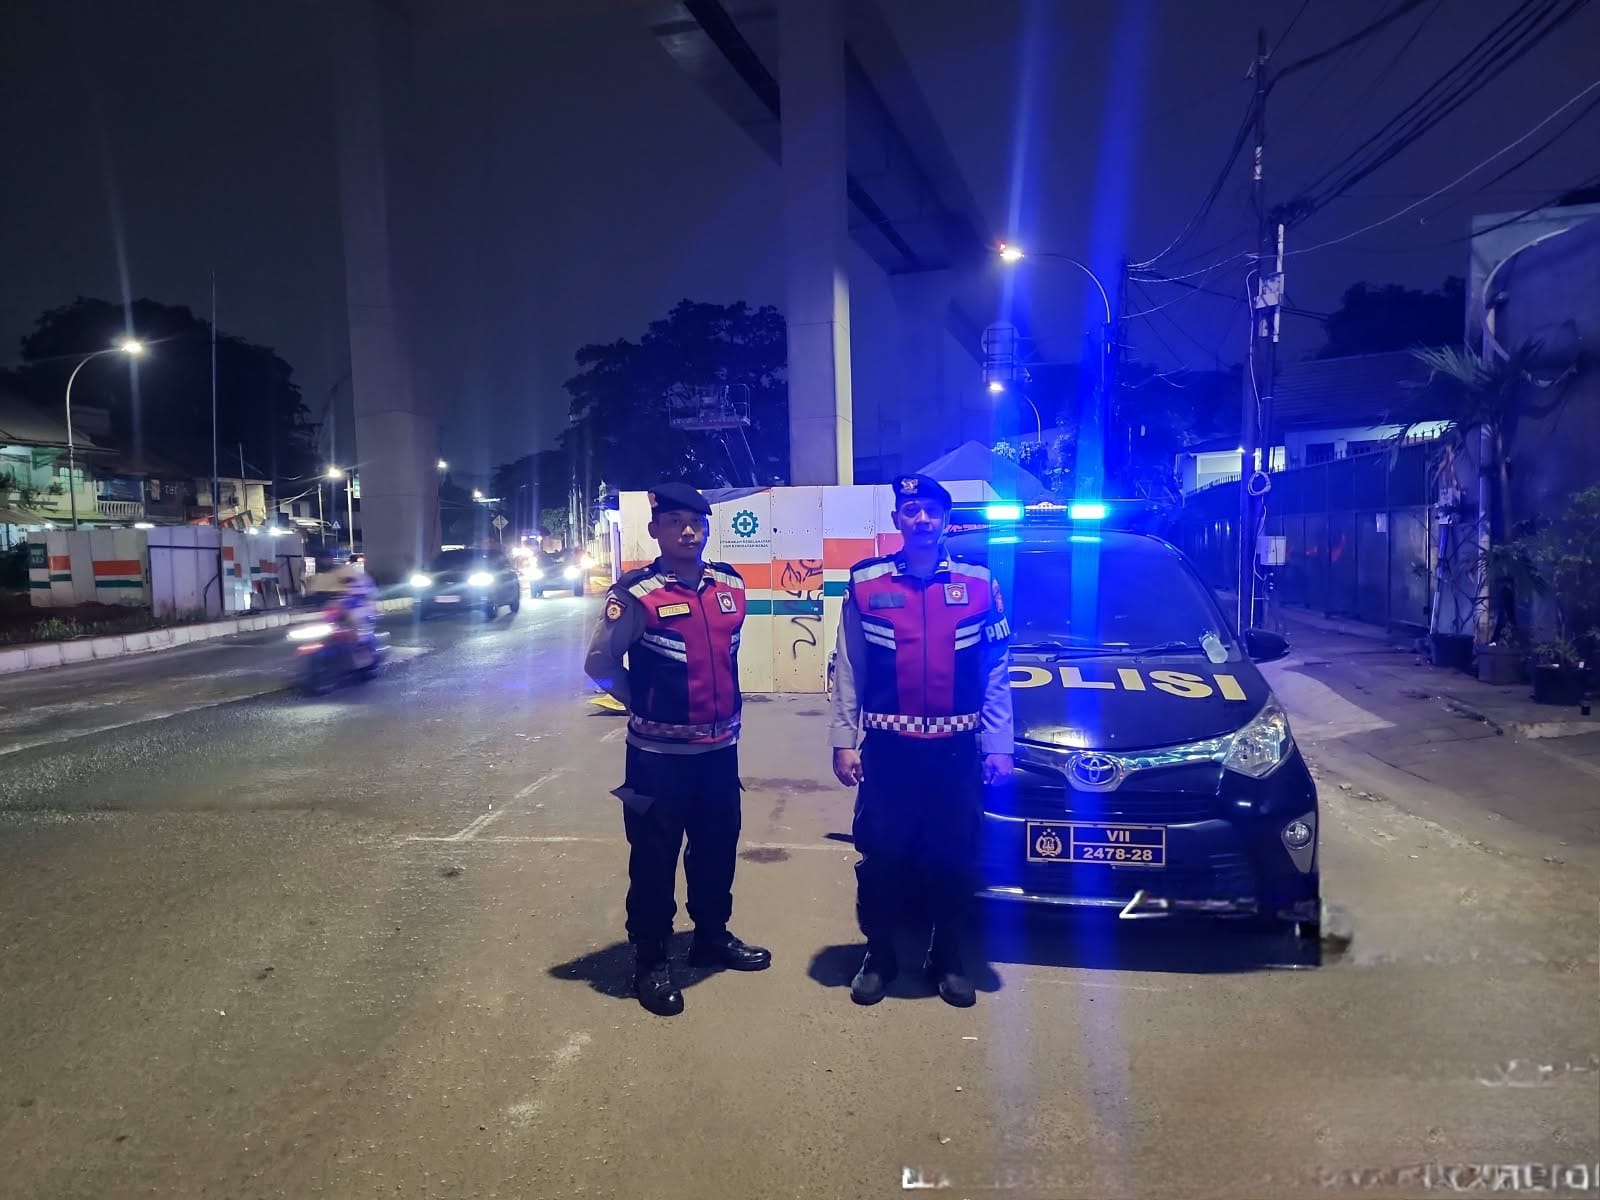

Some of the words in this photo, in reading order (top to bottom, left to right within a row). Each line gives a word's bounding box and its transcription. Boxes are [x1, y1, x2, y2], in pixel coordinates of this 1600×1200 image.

[1008, 666, 1247, 700] OLISI
[1106, 830, 1130, 842] VII
[1083, 847, 1153, 861] 2478-28
